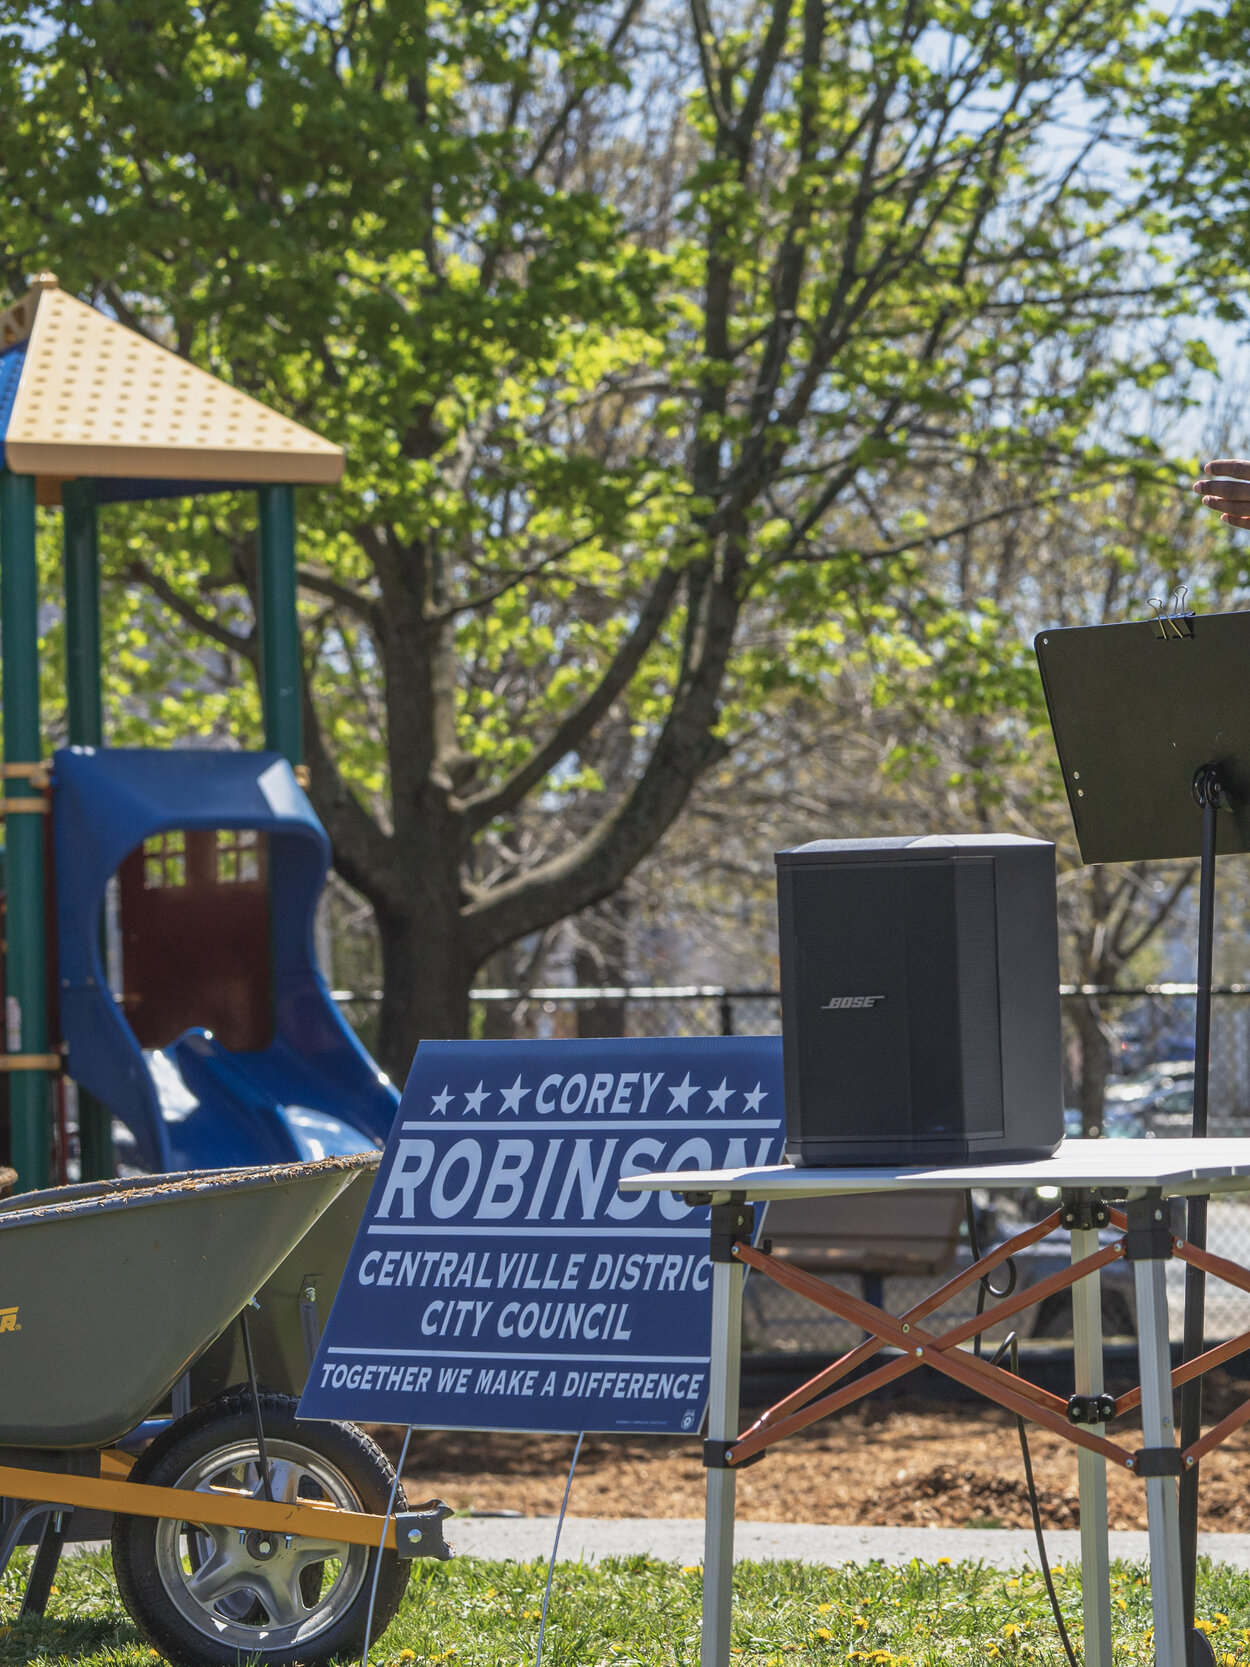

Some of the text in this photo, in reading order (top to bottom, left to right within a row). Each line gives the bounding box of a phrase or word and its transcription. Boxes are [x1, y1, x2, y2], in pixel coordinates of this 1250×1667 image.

[821, 995, 886, 1010] BOSE
[535, 1072, 665, 1114] COREY
[358, 1250, 714, 1292] CENTRALVILLE DISTRIC
[421, 1299, 632, 1341] CITY COUNCIL
[320, 1362, 705, 1400] TOGETHER WE MAKE A DIFFERENCE
